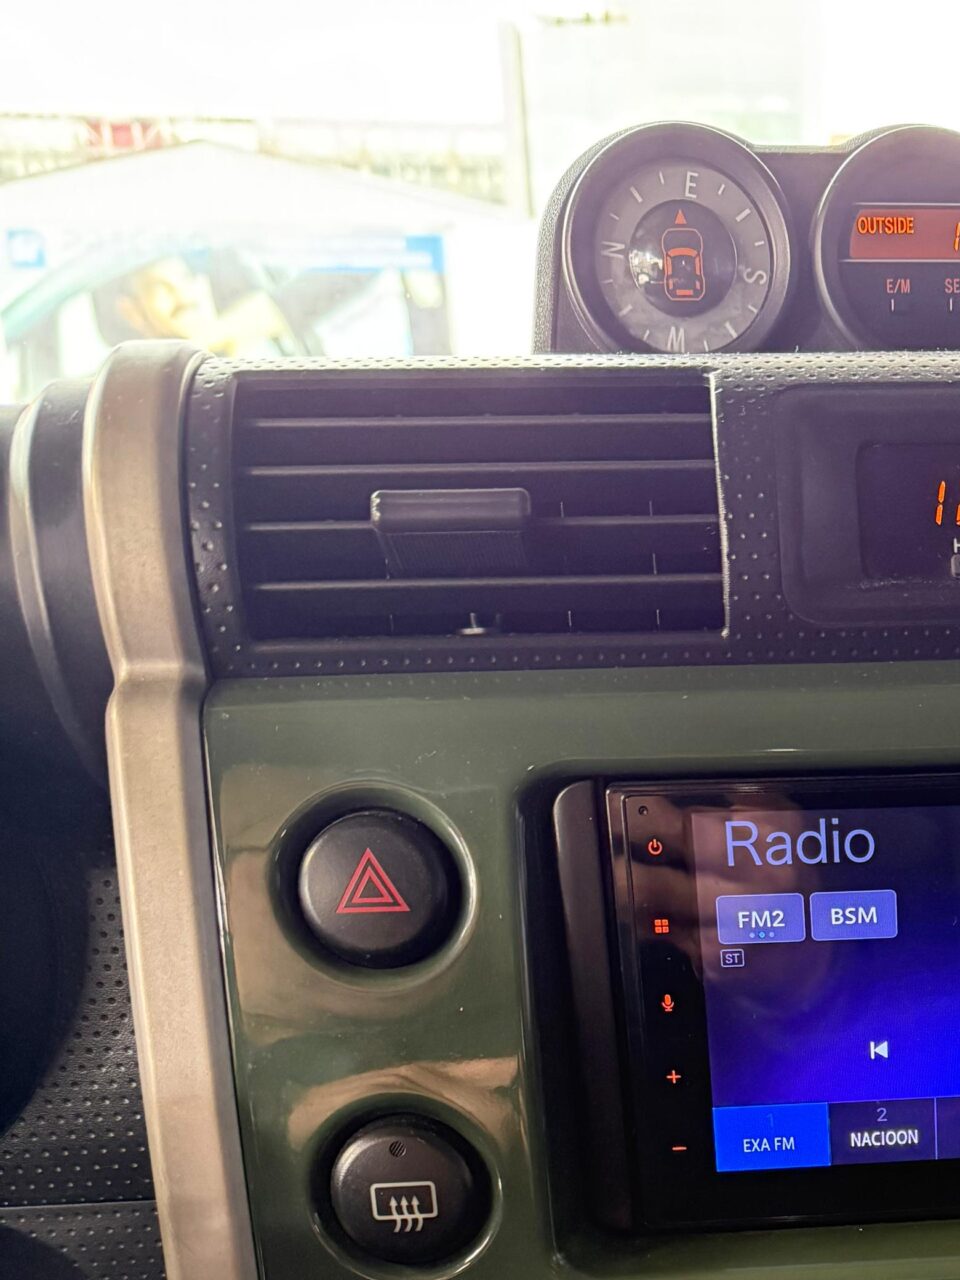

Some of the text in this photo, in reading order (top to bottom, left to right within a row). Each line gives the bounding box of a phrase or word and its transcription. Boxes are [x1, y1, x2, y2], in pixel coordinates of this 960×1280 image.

[684, 170, 699, 199] E
[857, 216, 915, 235] OUTSIDE
[886, 278, 911, 294] E/M
[724, 817, 876, 867] Radio
[737, 910, 786, 929] FM2
[830, 906, 878, 926] BSM
[725, 953, 741, 965] ST
[876, 1107, 888, 1122] 2
[743, 1136, 795, 1153] EXA FM
[850, 1129, 919, 1148] NACIOON
